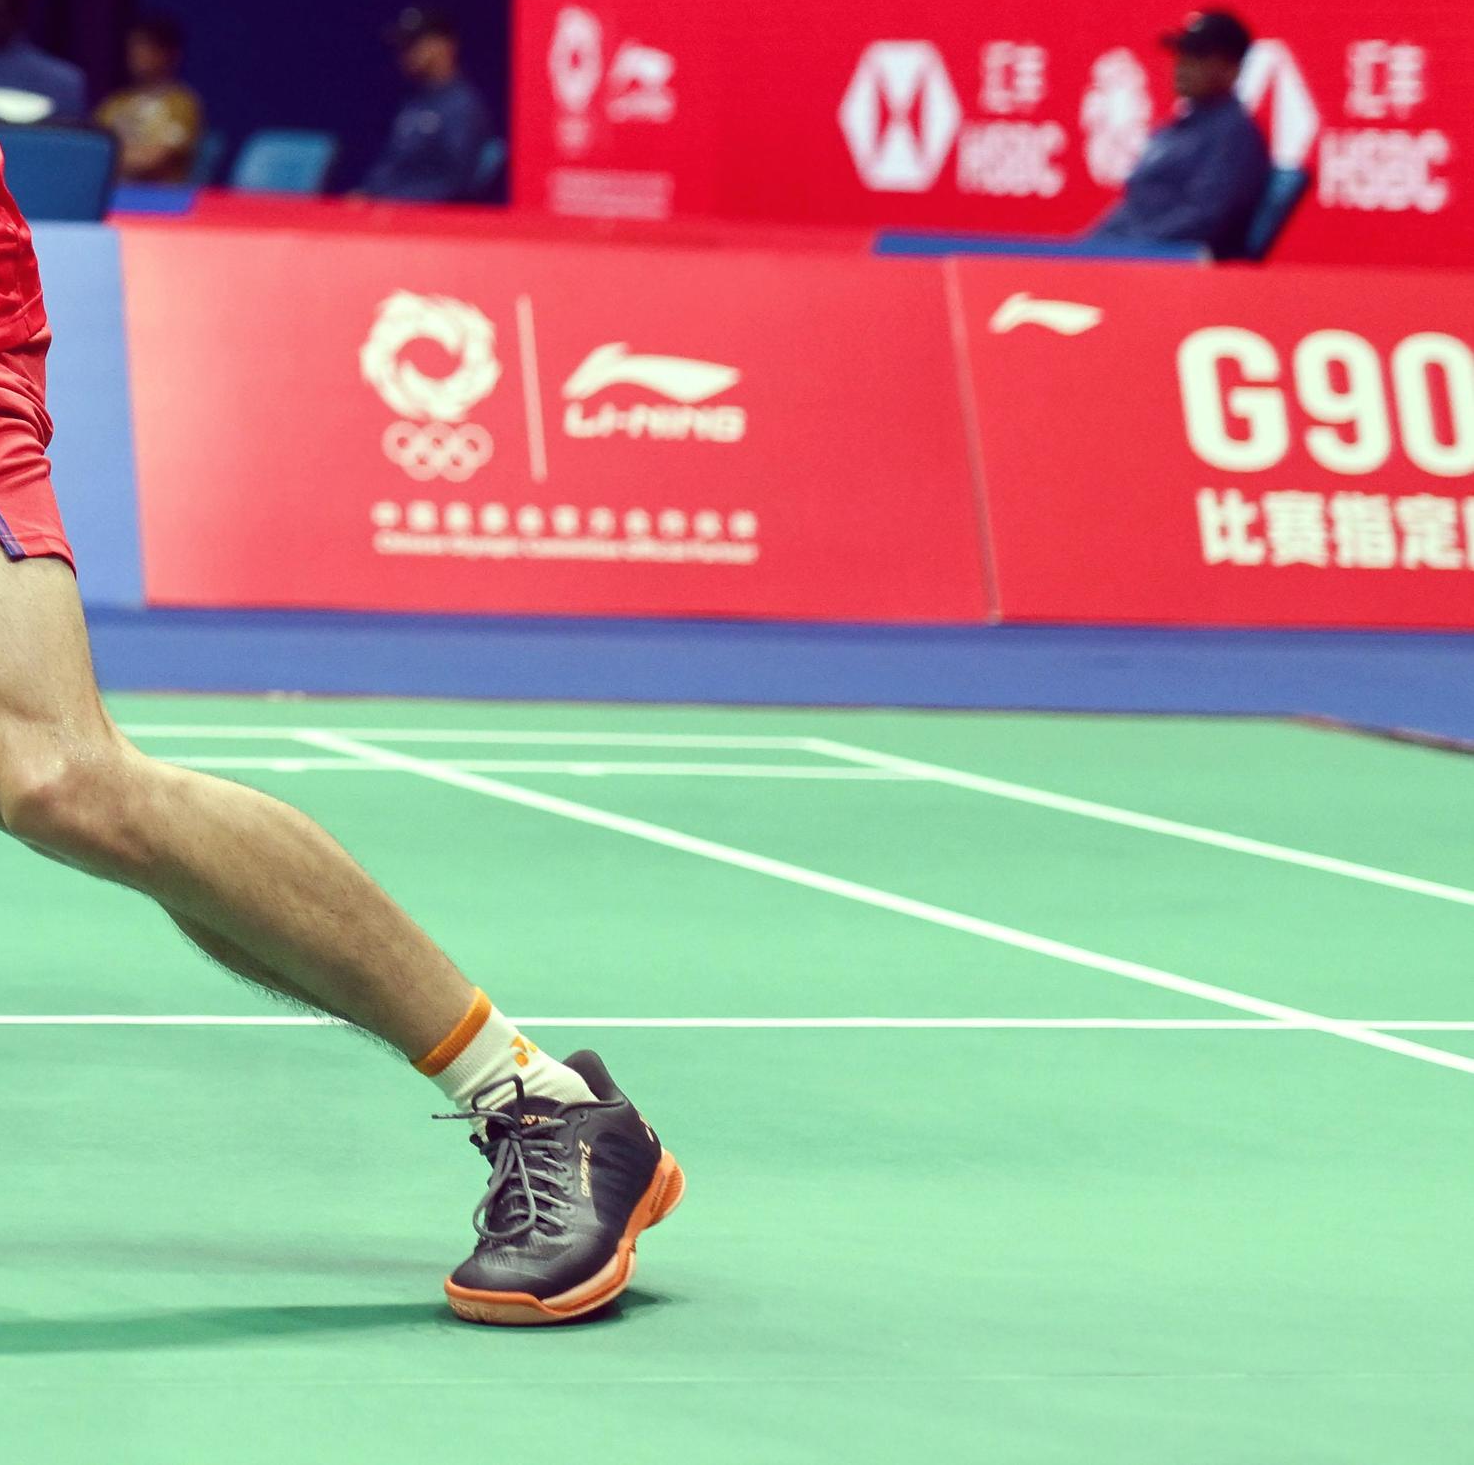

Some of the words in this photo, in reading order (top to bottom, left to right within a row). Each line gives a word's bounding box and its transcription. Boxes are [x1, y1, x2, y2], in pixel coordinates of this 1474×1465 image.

[956, 120, 1066, 199] HSBC
[1318, 129, 1449, 214] HSBC
[564, 403, 746, 443] LI-NING
[1176, 325, 1474, 478] G90
[1196, 486, 1474, 571] 比赛指定
